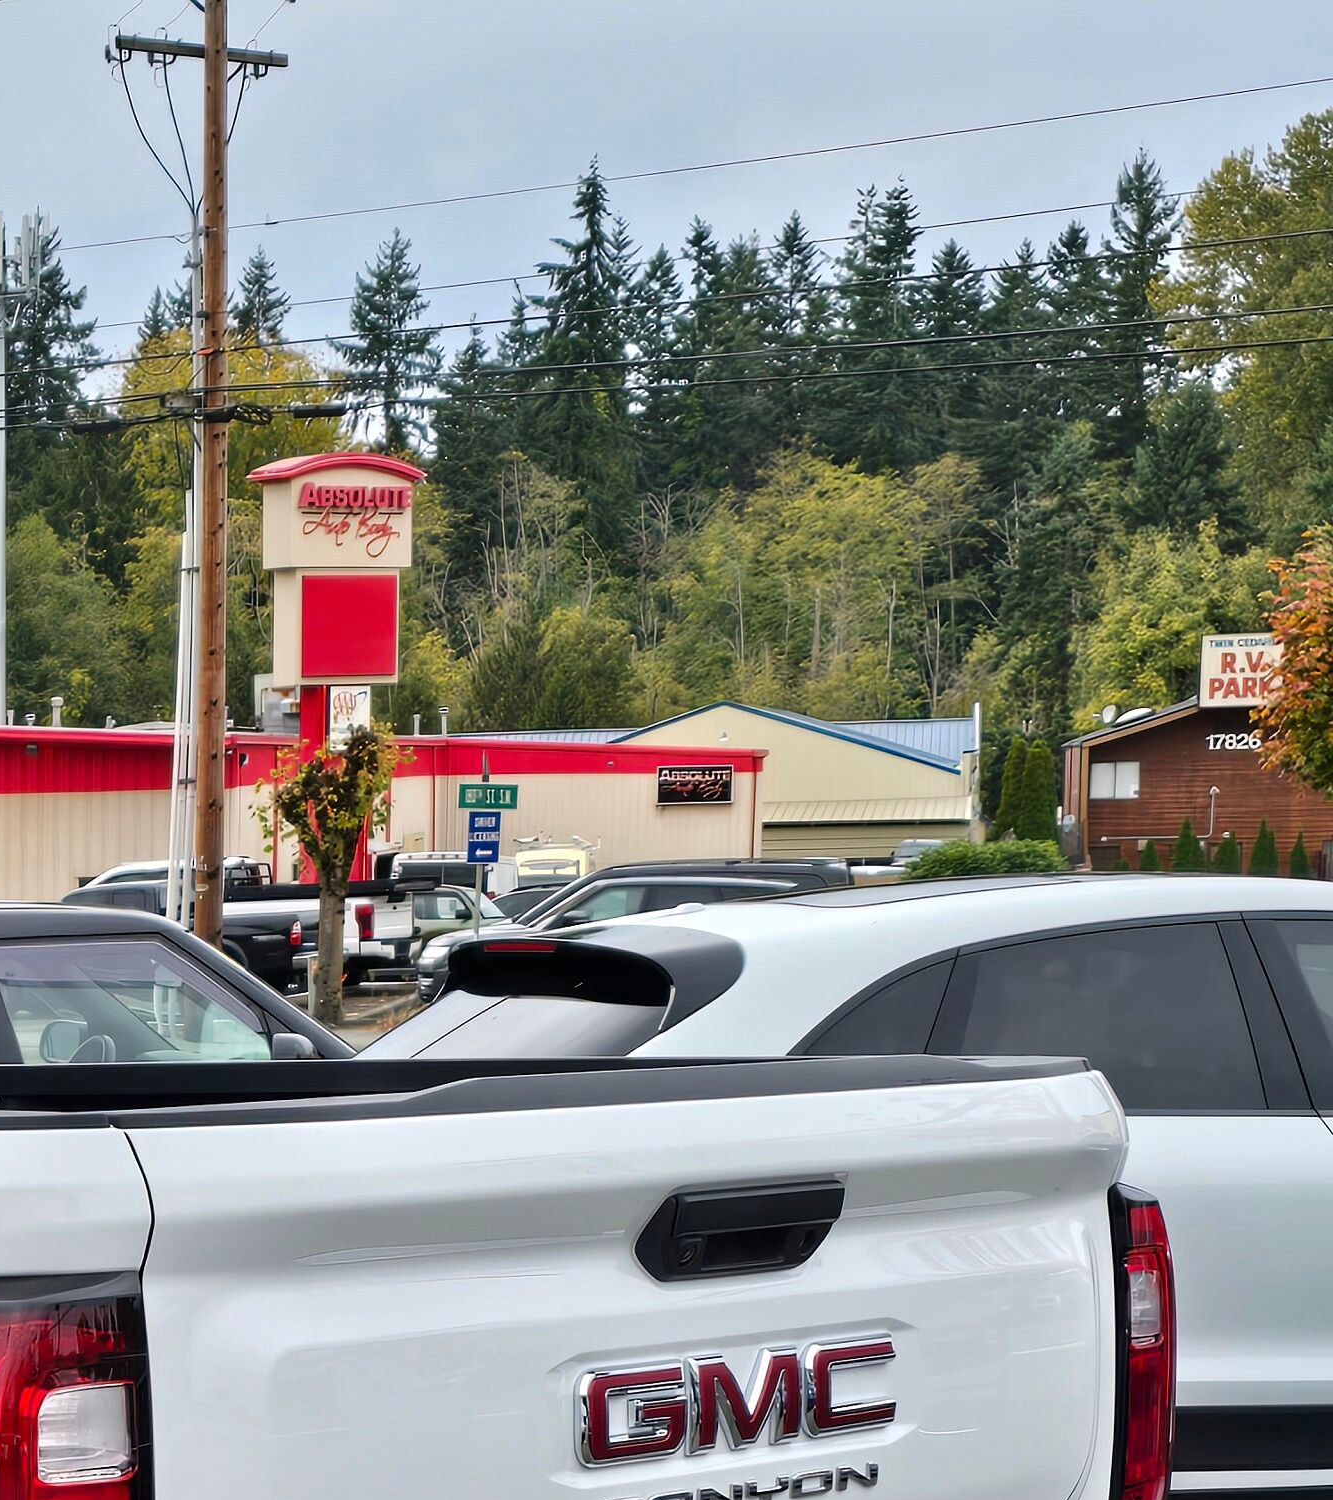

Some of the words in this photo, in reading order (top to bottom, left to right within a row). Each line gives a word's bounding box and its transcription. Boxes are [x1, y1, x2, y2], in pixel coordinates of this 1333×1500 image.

[298, 482, 412, 508] ABSOLUTE
[1221, 651, 1270, 674] R.V
[1209, 677, 1272, 699] PARK
[1205, 730, 1262, 750] 17826
[659, 770, 731, 781] ABSOLUTE
[574, 1334, 897, 1468] GMC
